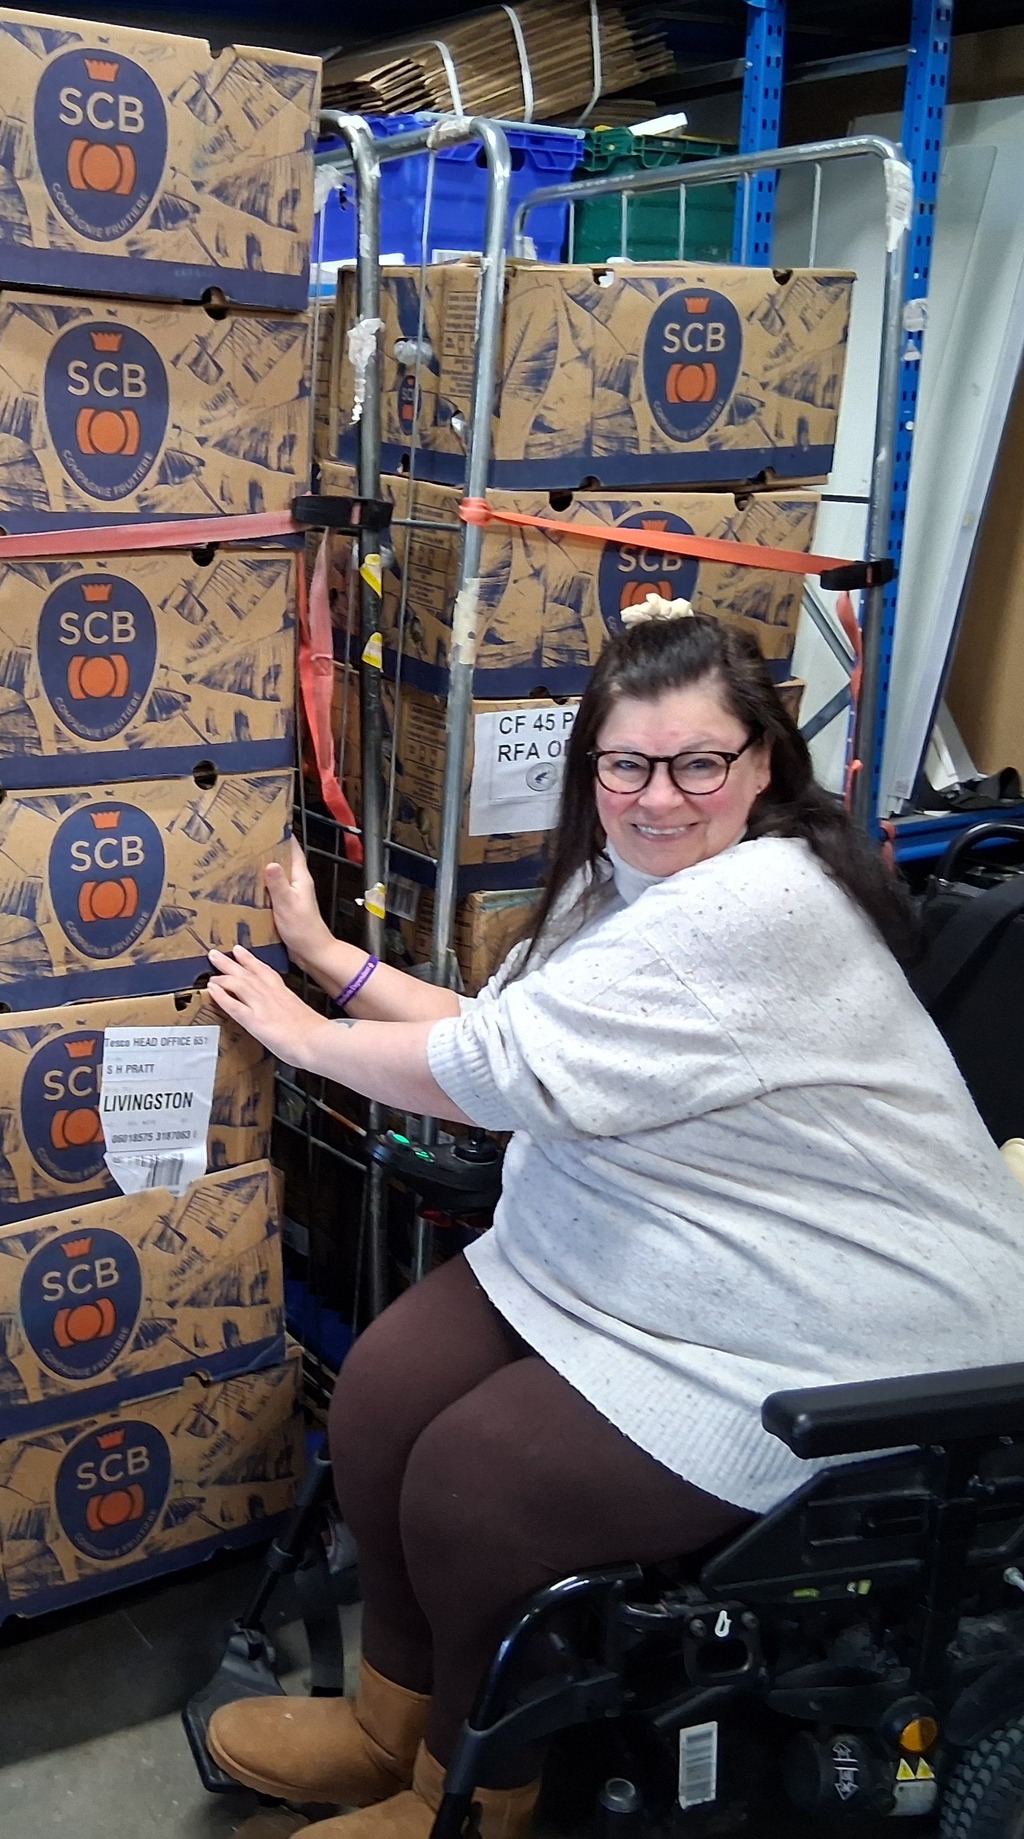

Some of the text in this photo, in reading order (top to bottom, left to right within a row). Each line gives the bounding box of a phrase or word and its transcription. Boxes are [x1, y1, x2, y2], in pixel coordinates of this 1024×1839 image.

[59, 87, 145, 133] SCB
[662, 322, 726, 354] SCB
[67, 360, 147, 398] SCB
[617, 545, 683, 572] SCB
[58, 611, 137, 645] SCB
[499, 714, 526, 735] CF
[533, 713, 555, 732] 45
[498, 742, 540, 762] RFA
[70, 835, 145, 872] SCB
[133, 1037, 158, 1047] HEAD
[160, 1036, 190, 1046] OFFICE
[43, 1064, 103, 1101] SC
[106, 1063, 155, 1074] S H PRATT
[103, 1091, 194, 1113] LIVINGSTON
[41, 1257, 120, 1301] SCB
[76, 1446, 151, 1490] SCB
